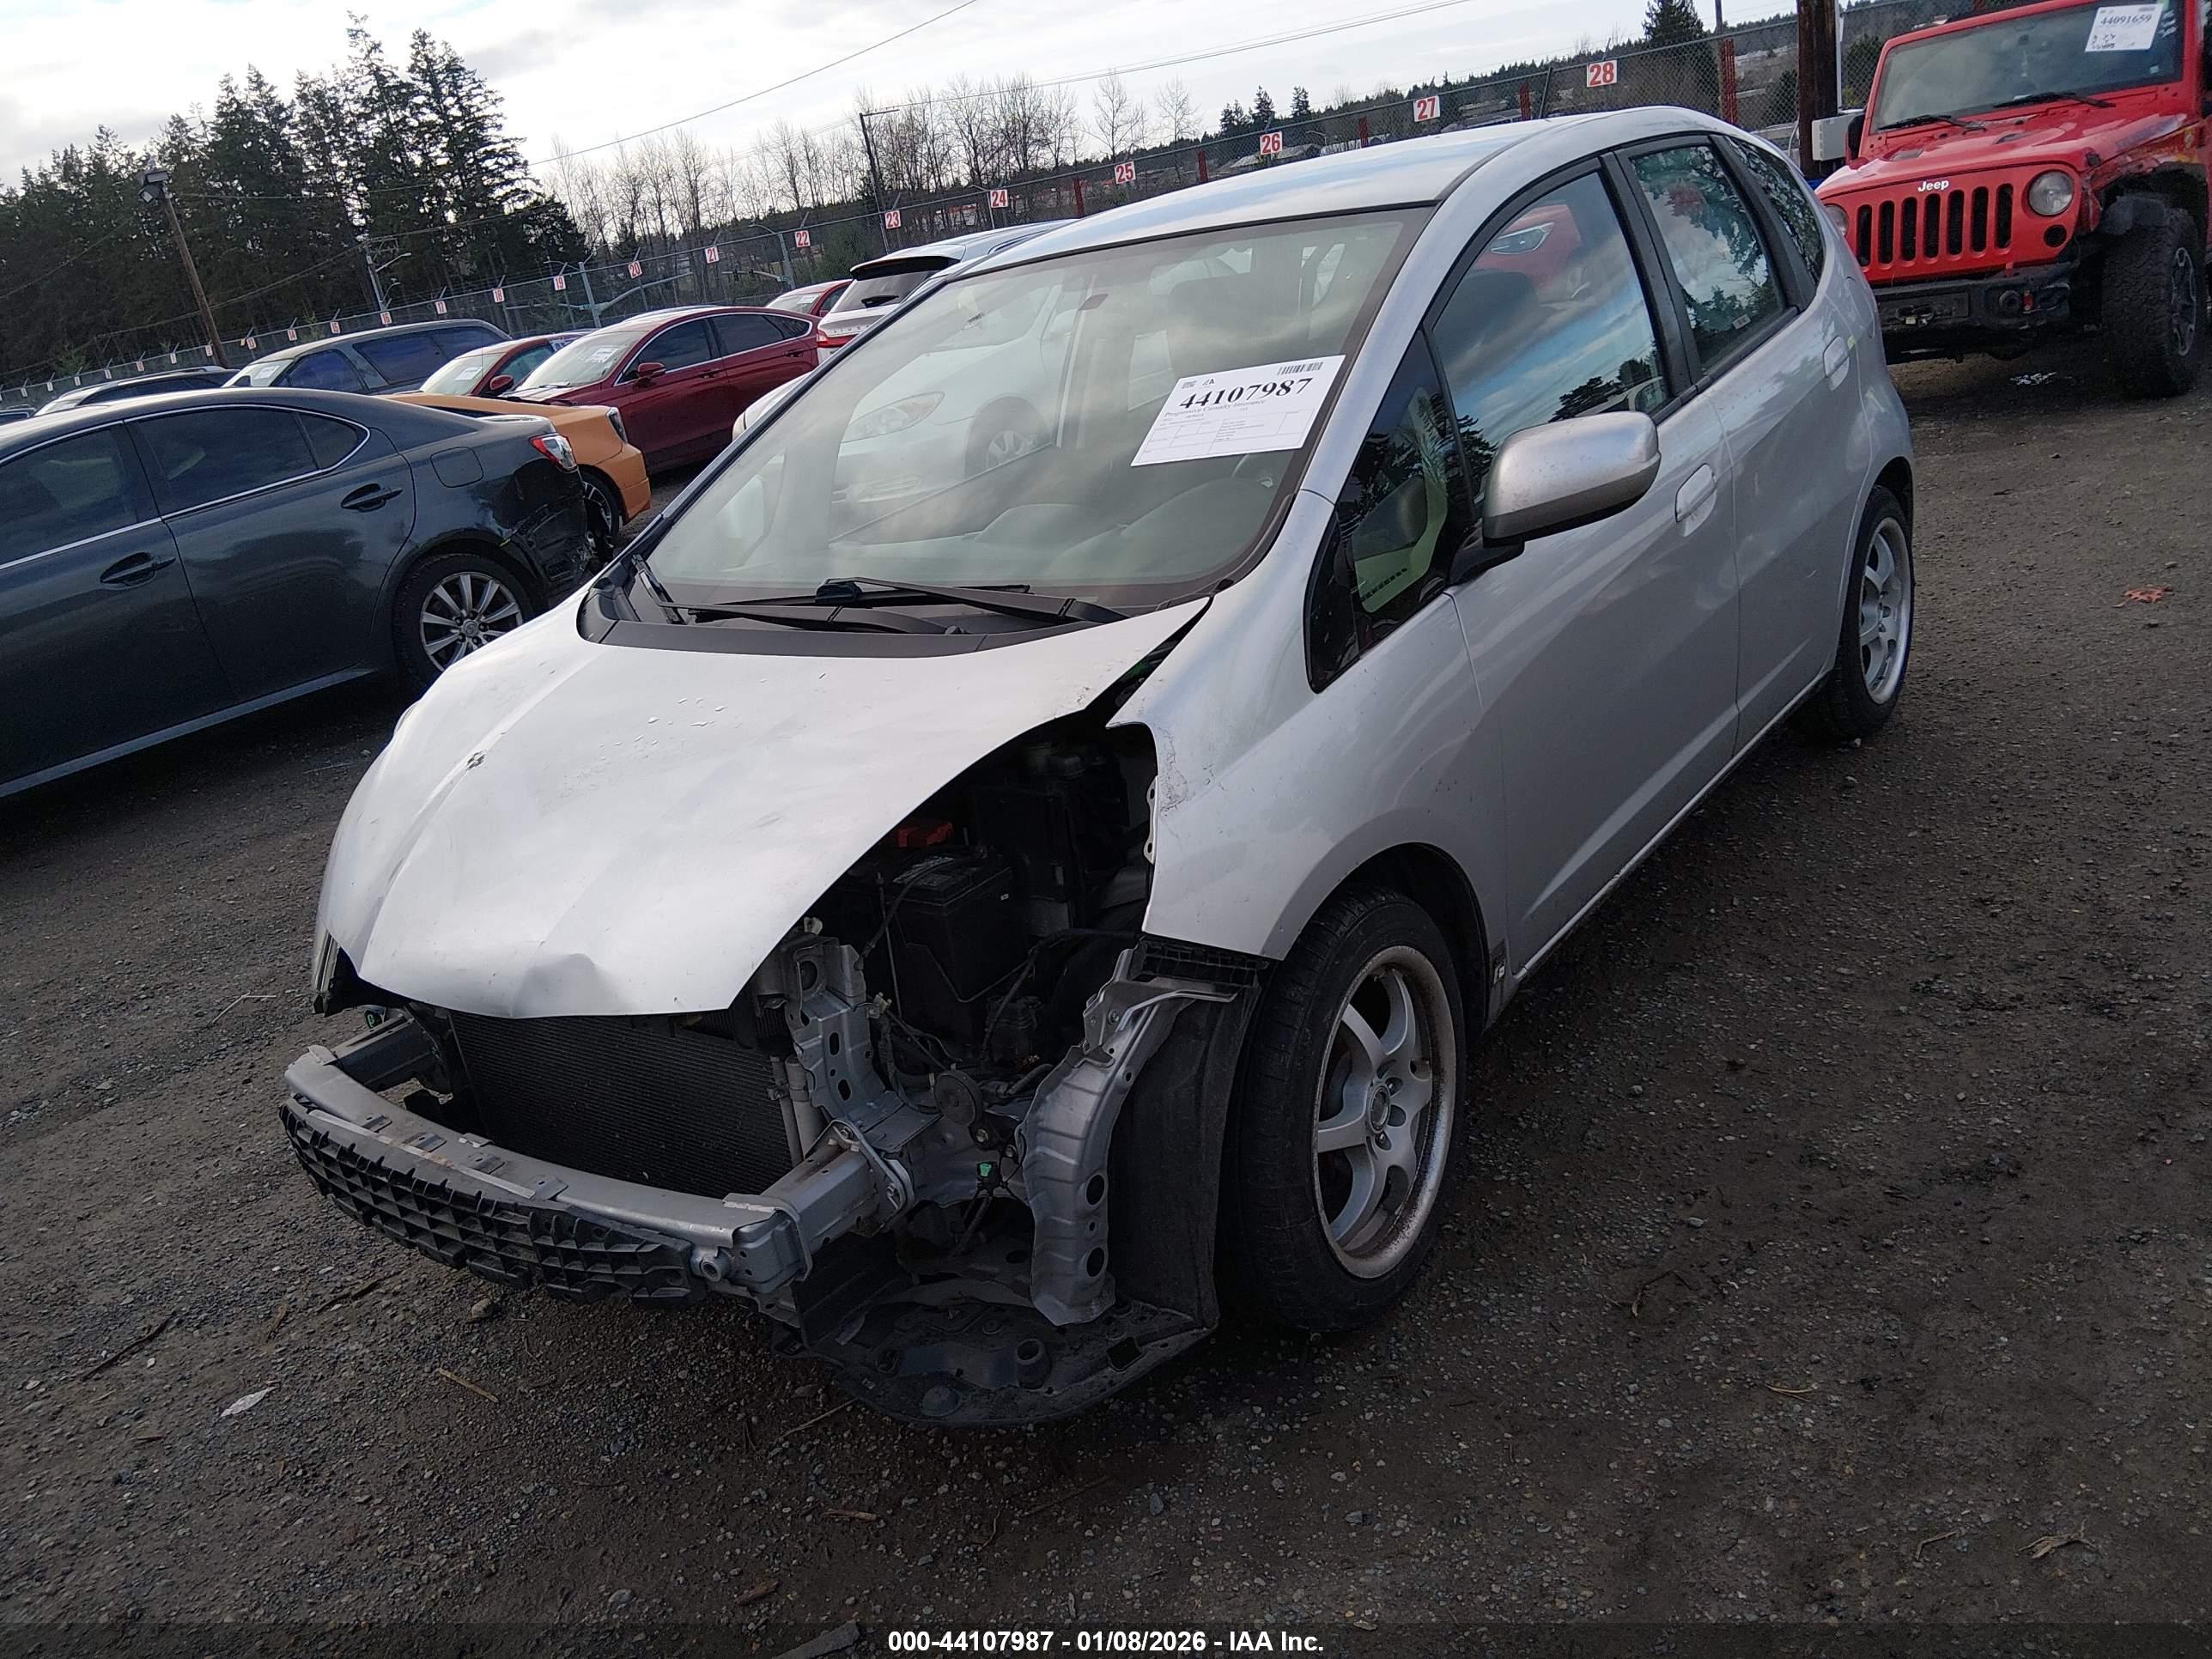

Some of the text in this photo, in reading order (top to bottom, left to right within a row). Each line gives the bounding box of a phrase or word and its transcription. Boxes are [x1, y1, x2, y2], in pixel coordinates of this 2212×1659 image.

[2100, 14, 2152, 25] 44091659
[1589, 61, 1614, 86] 28
[1417, 97, 1437, 120] 27
[1261, 133, 1281, 154] 26
[1116, 163, 1134, 183] 25
[1917, 180, 1949, 192] Jeep
[992, 191, 1007, 207] 24
[886, 211, 900, 228] 23
[796, 231, 809, 246] 22
[707, 247, 717, 263] 21
[629, 263, 641, 277] 20
[556, 276, 564, 289] 19
[495, 289, 503, 301] 18
[1179, 378, 1313, 409] 44107987
